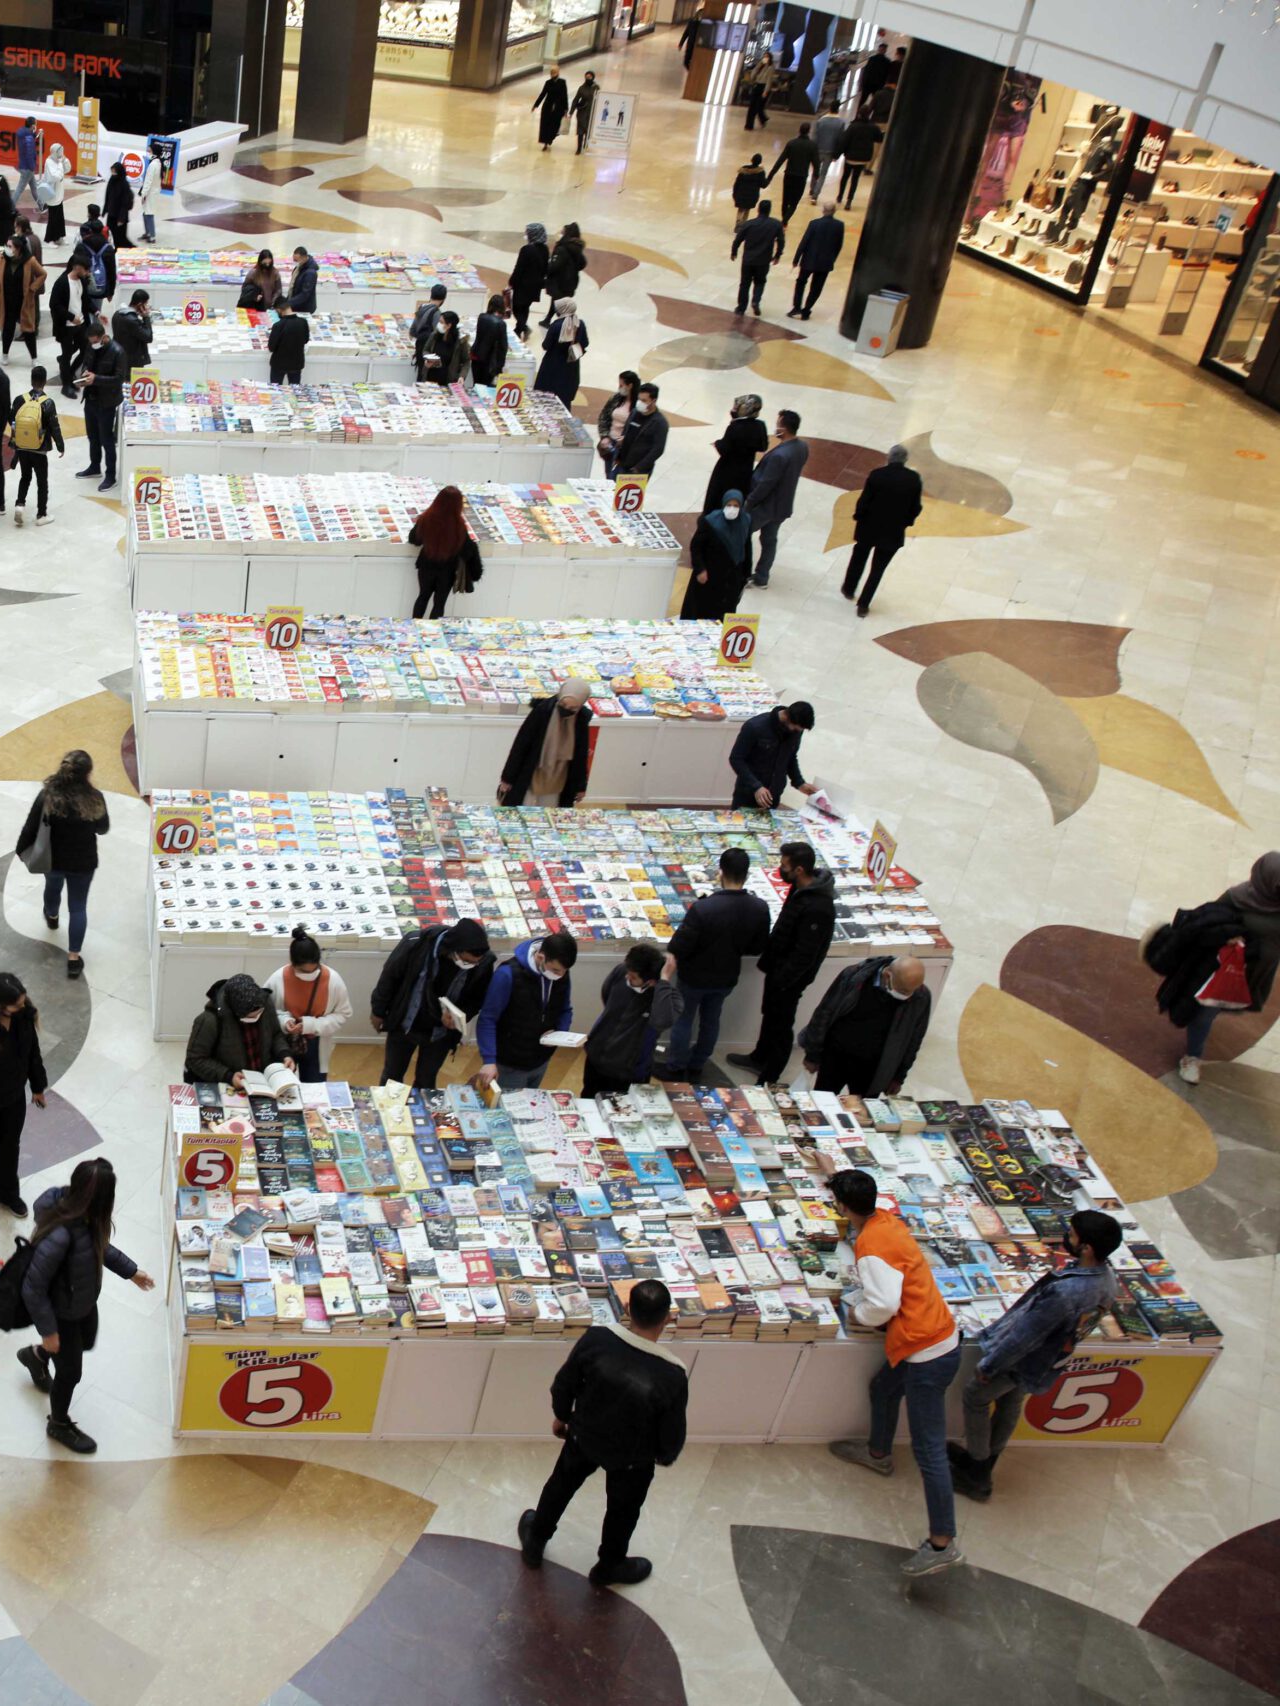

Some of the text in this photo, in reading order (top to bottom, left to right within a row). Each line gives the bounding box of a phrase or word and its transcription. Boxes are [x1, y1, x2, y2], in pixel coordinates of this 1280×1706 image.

[133, 382, 155, 401] 20
[497, 387, 520, 407] 20
[138, 482, 161, 504] 15
[617, 488, 641, 510] 15
[269, 622, 298, 647] 10
[725, 631, 754, 658] 10
[161, 824, 195, 850] 10
[869, 842, 886, 880] 10
[193, 1152, 224, 1185] 5
[225, 1349, 267, 1361] Tüm
[237, 1351, 320, 1368] Kitaplar
[245, 1365, 304, 1426] 5
[1043, 1371, 1119, 1432] 5
[302, 1411, 341, 1422] Lira
[1100, 1417, 1141, 1428] Lira
